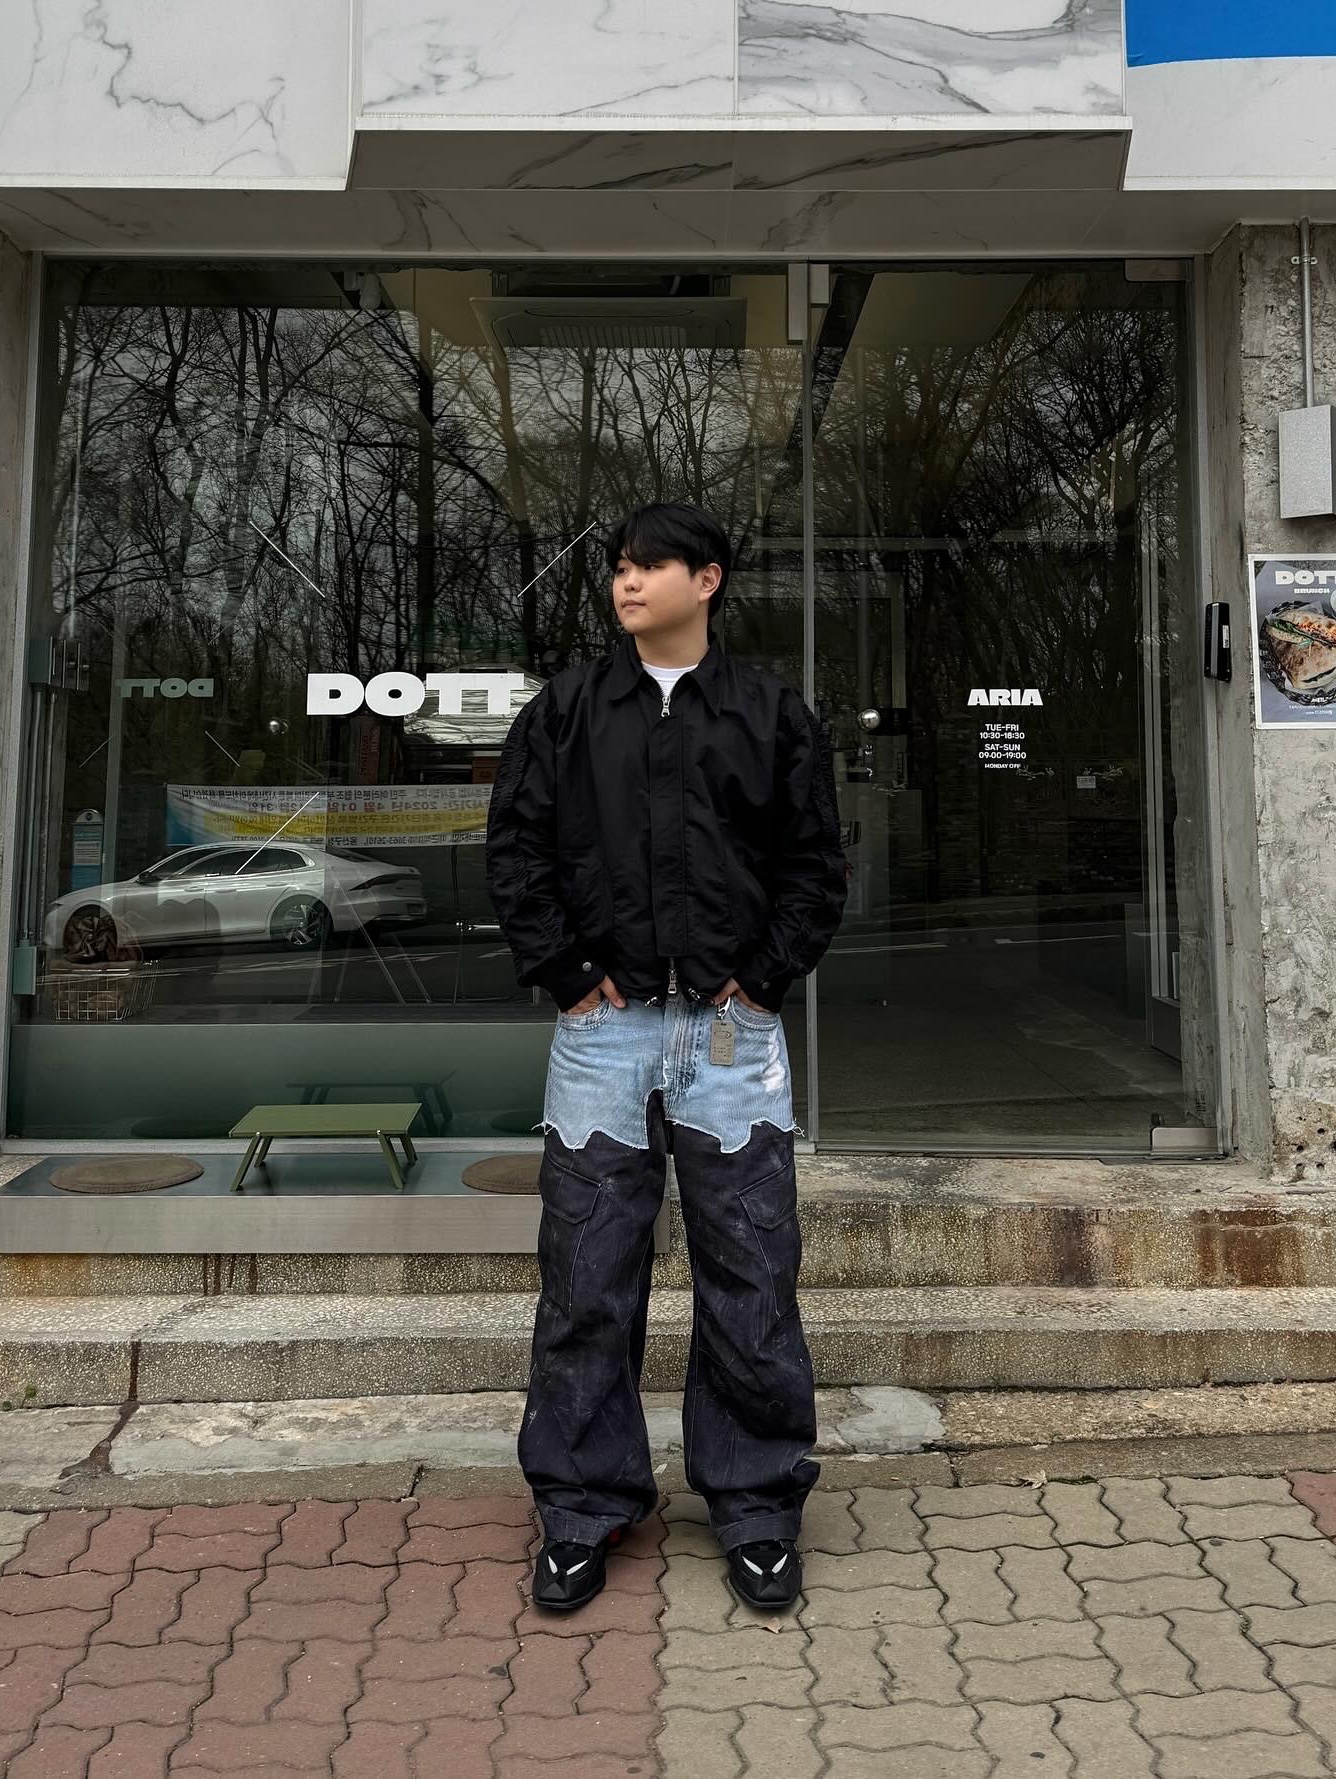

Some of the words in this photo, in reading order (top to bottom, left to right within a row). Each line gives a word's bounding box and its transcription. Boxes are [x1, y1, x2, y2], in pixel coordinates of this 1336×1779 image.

[306, 671, 525, 717] DOTT
[967, 688, 1044, 706] ARIA
[985, 723, 1019, 731] TUE-FRI
[984, 743, 1021, 751] SAT-SUN
